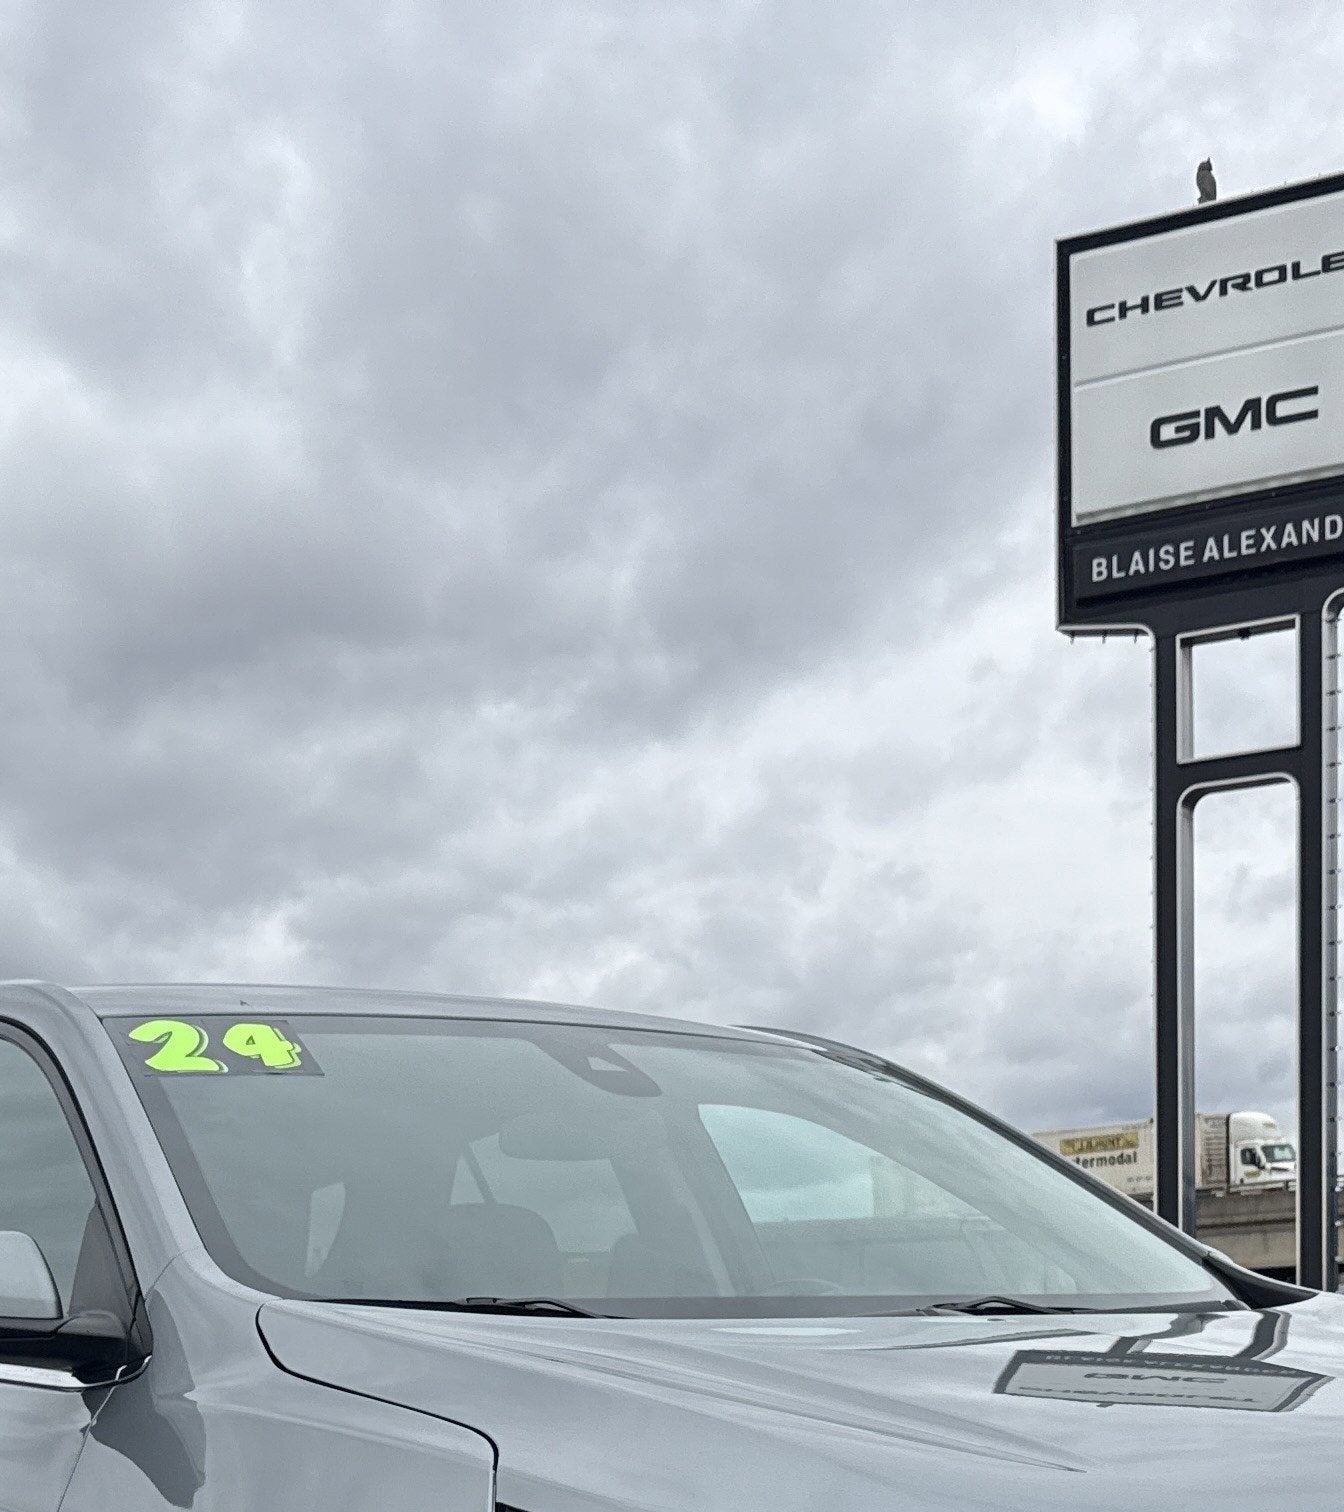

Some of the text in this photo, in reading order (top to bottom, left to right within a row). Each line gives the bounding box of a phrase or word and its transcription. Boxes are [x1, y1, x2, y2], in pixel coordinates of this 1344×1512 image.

[1149, 385, 1319, 450] GMC
[1091, 540, 1196, 583] BLAISE
[128, 1019, 302, 1073] 24
[1072, 1150, 1138, 1168] termodal
